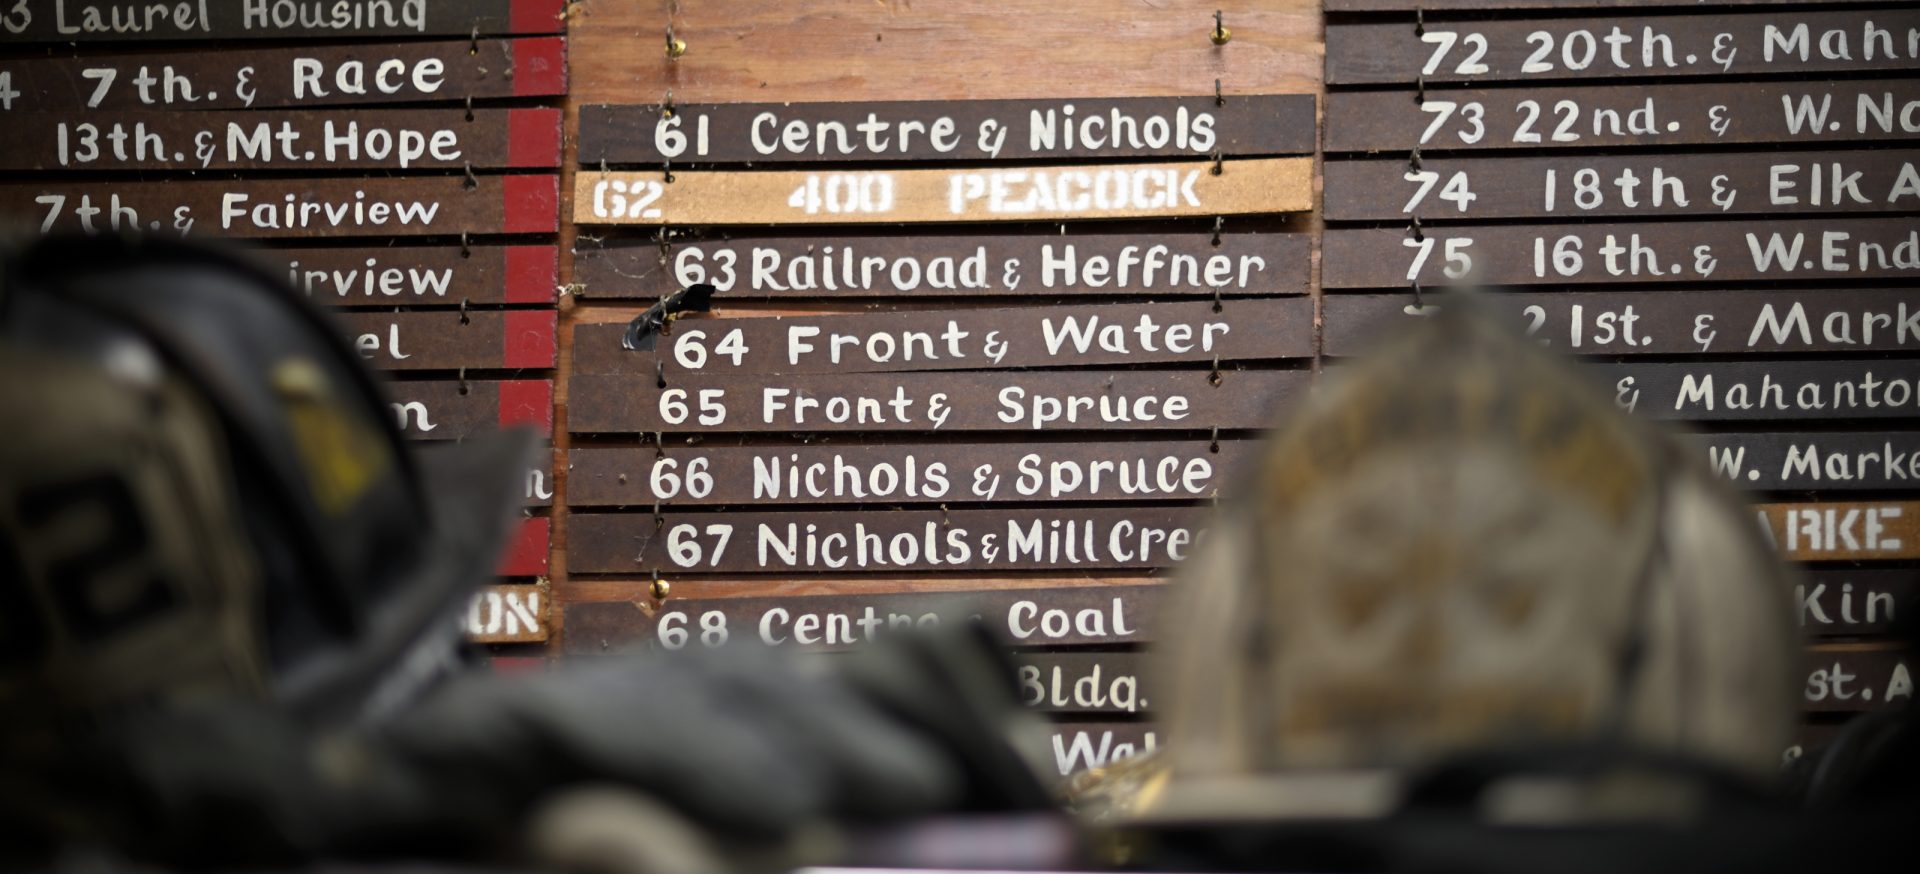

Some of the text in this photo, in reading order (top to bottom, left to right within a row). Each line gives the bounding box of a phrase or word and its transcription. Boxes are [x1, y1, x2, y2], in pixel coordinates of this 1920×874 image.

[0, 0, 32, 34] 3
[55, 0, 210, 34] Laurel
[1421, 31, 1489, 75] 72
[1521, 26, 1697, 74] 20th.
[1712, 32, 1737, 72] &
[235, 66, 256, 108] &
[293, 58, 445, 99] Race
[655, 104, 1216, 158] 61 Centre & Nichols
[1420, 101, 1485, 144] 73
[1513, 98, 1680, 143] 22nd.
[1709, 104, 1730, 138] &
[57, 122, 184, 166] 13th.
[195, 131, 216, 168] &
[593, 169, 1201, 218] 62 400 PEACOCK
[1403, 170, 1477, 213] 74
[1545, 167, 1690, 211] 18th
[1711, 174, 1737, 211] &
[1769, 162, 1873, 206] Elk
[173, 205, 195, 236] &
[221, 191, 440, 229] Fairview
[289, 257, 453, 296] irview
[675, 245, 1265, 292] 63 Railroad & Heffner
[1402, 237, 1474, 281] 75
[1694, 244, 1718, 278] &
[355, 323, 411, 359] el
[674, 314, 1230, 369] 64 Front & Water
[1693, 313, 1717, 351] &
[659, 386, 1190, 429] 65 Front & Spruce
[1616, 371, 1920, 414] & Mahanto
[650, 453, 1212, 500] 66 Nichols & Spruce
[1709, 446, 1761, 481] W.
[667, 518, 1208, 568] 67 Nichols & Mill Cre
[461, 592, 540, 637] ON
[657, 610, 729, 649] 68
[1008, 597, 1136, 639] Coal
[1804, 662, 1873, 702] st.
